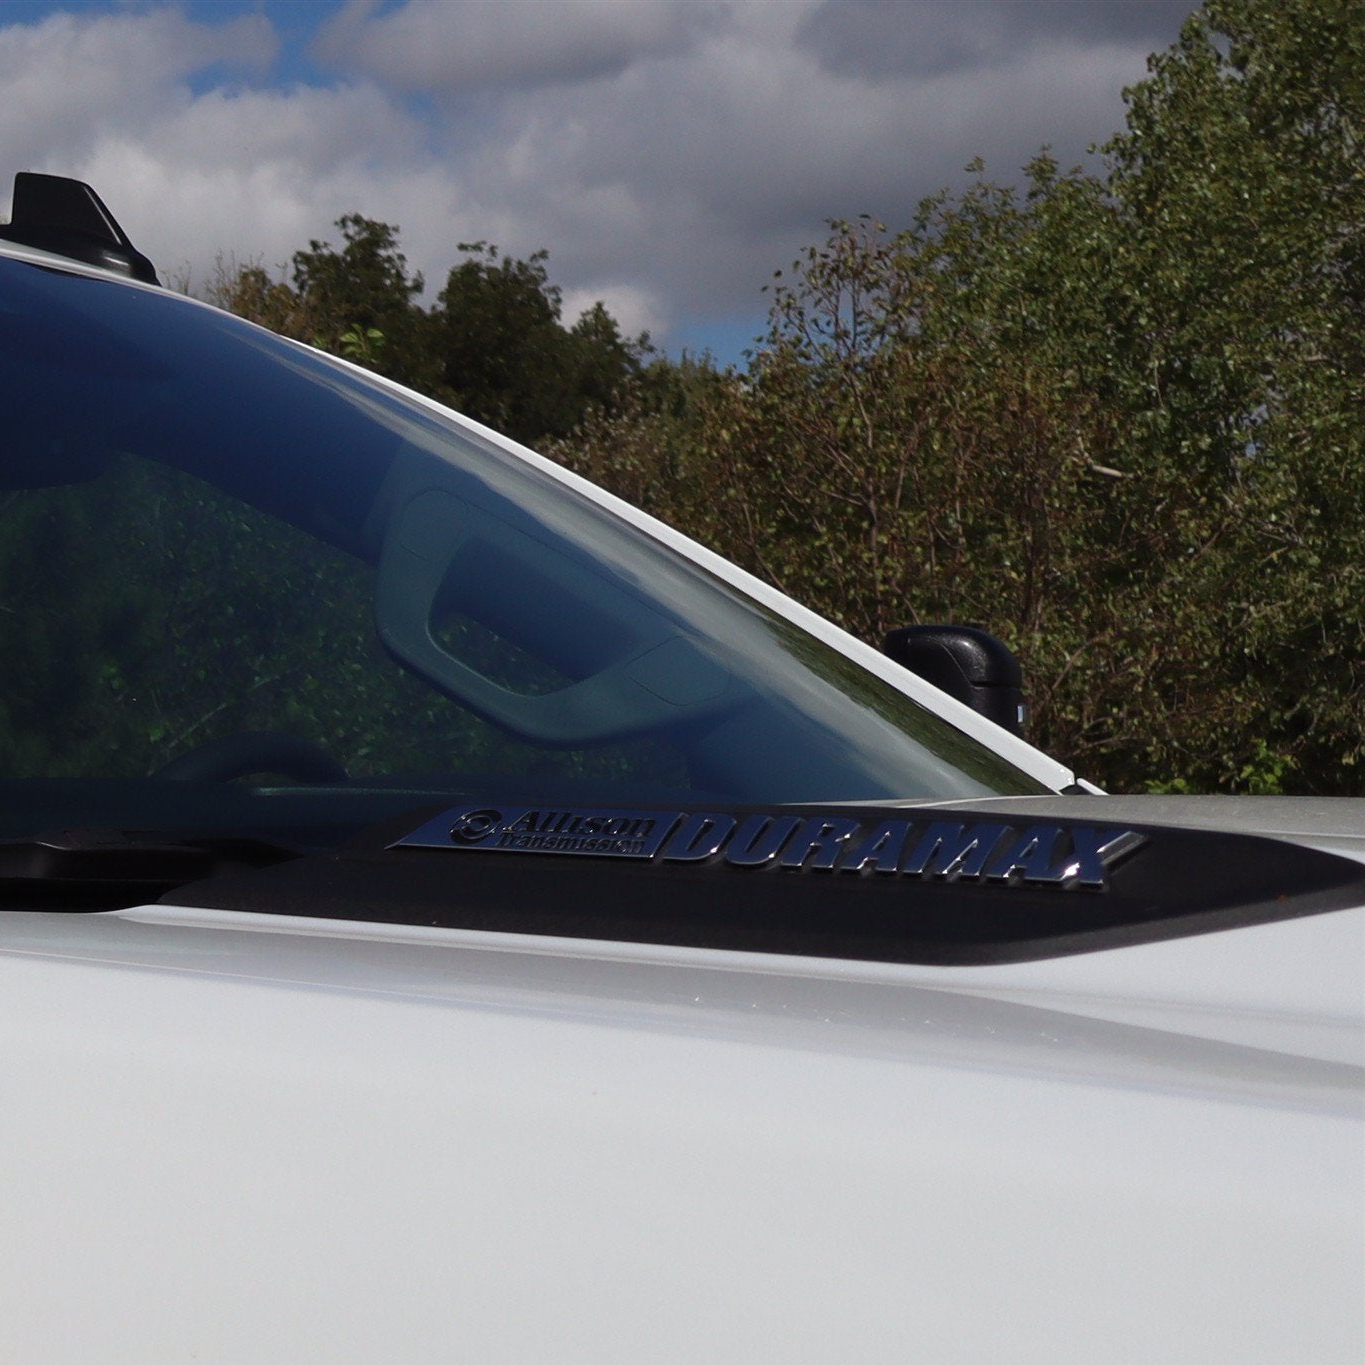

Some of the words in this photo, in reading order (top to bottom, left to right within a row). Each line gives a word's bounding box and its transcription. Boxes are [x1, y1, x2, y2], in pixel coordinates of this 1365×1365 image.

[501, 809, 656, 837] Allison
[495, 831, 645, 853] Transmission
[663, 811, 1147, 887] DURAMAX
